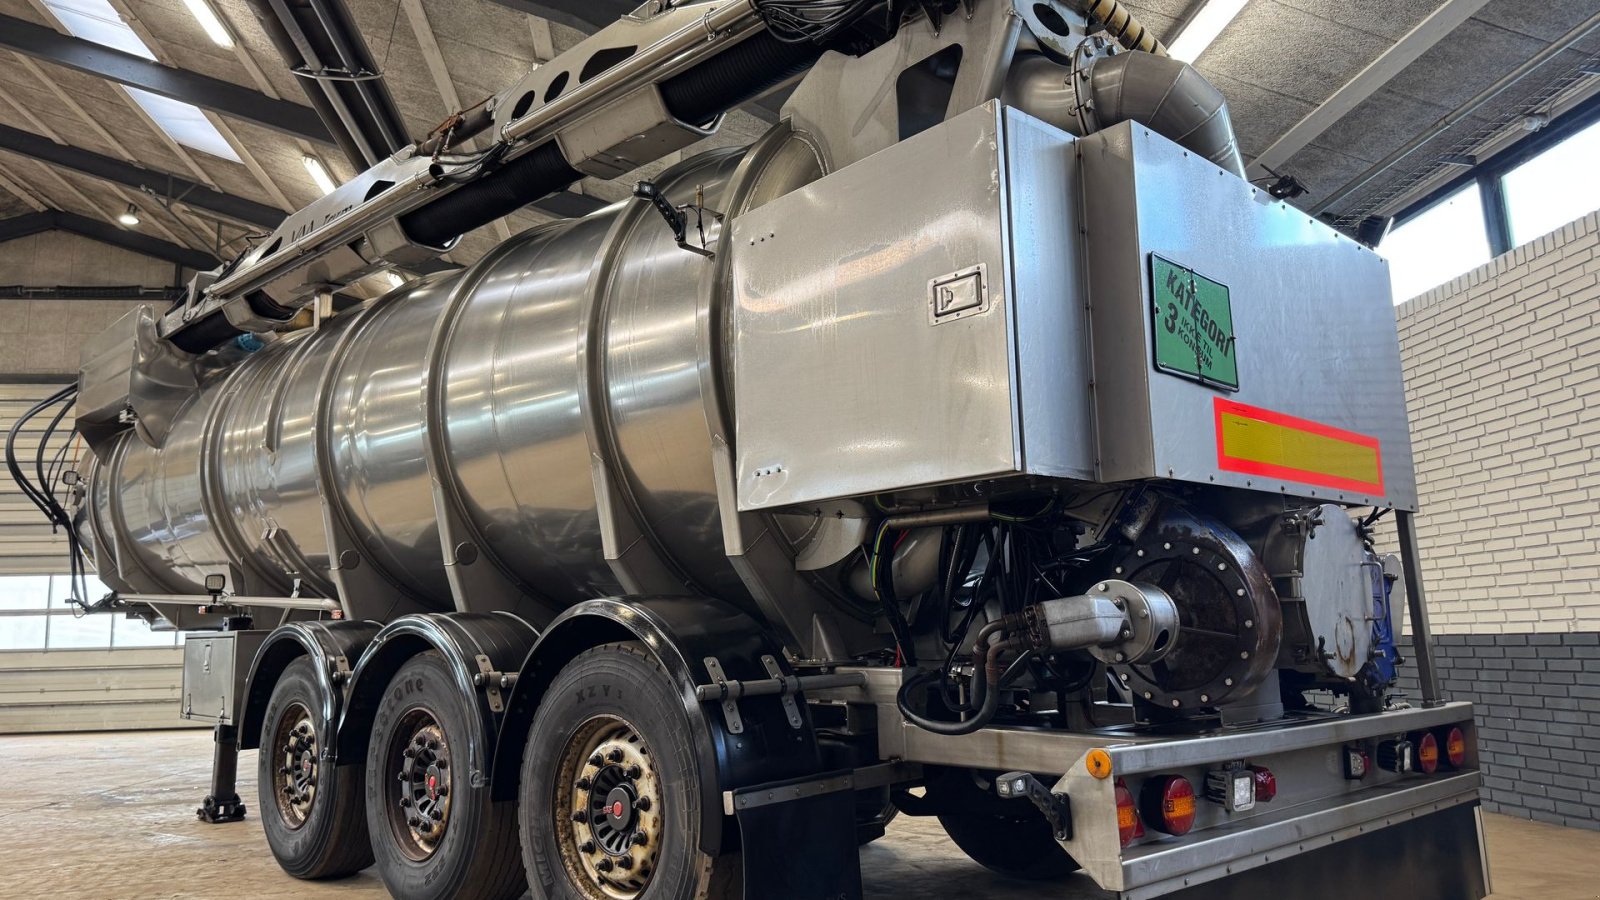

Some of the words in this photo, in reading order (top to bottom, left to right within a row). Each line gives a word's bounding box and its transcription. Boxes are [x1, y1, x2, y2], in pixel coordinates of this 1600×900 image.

[1164, 302, 1178, 334] 3
[1166, 268, 1231, 358] KATEGORI
[1181, 316, 1202, 341] IKKE
[1202, 339, 1213, 359] TIL
